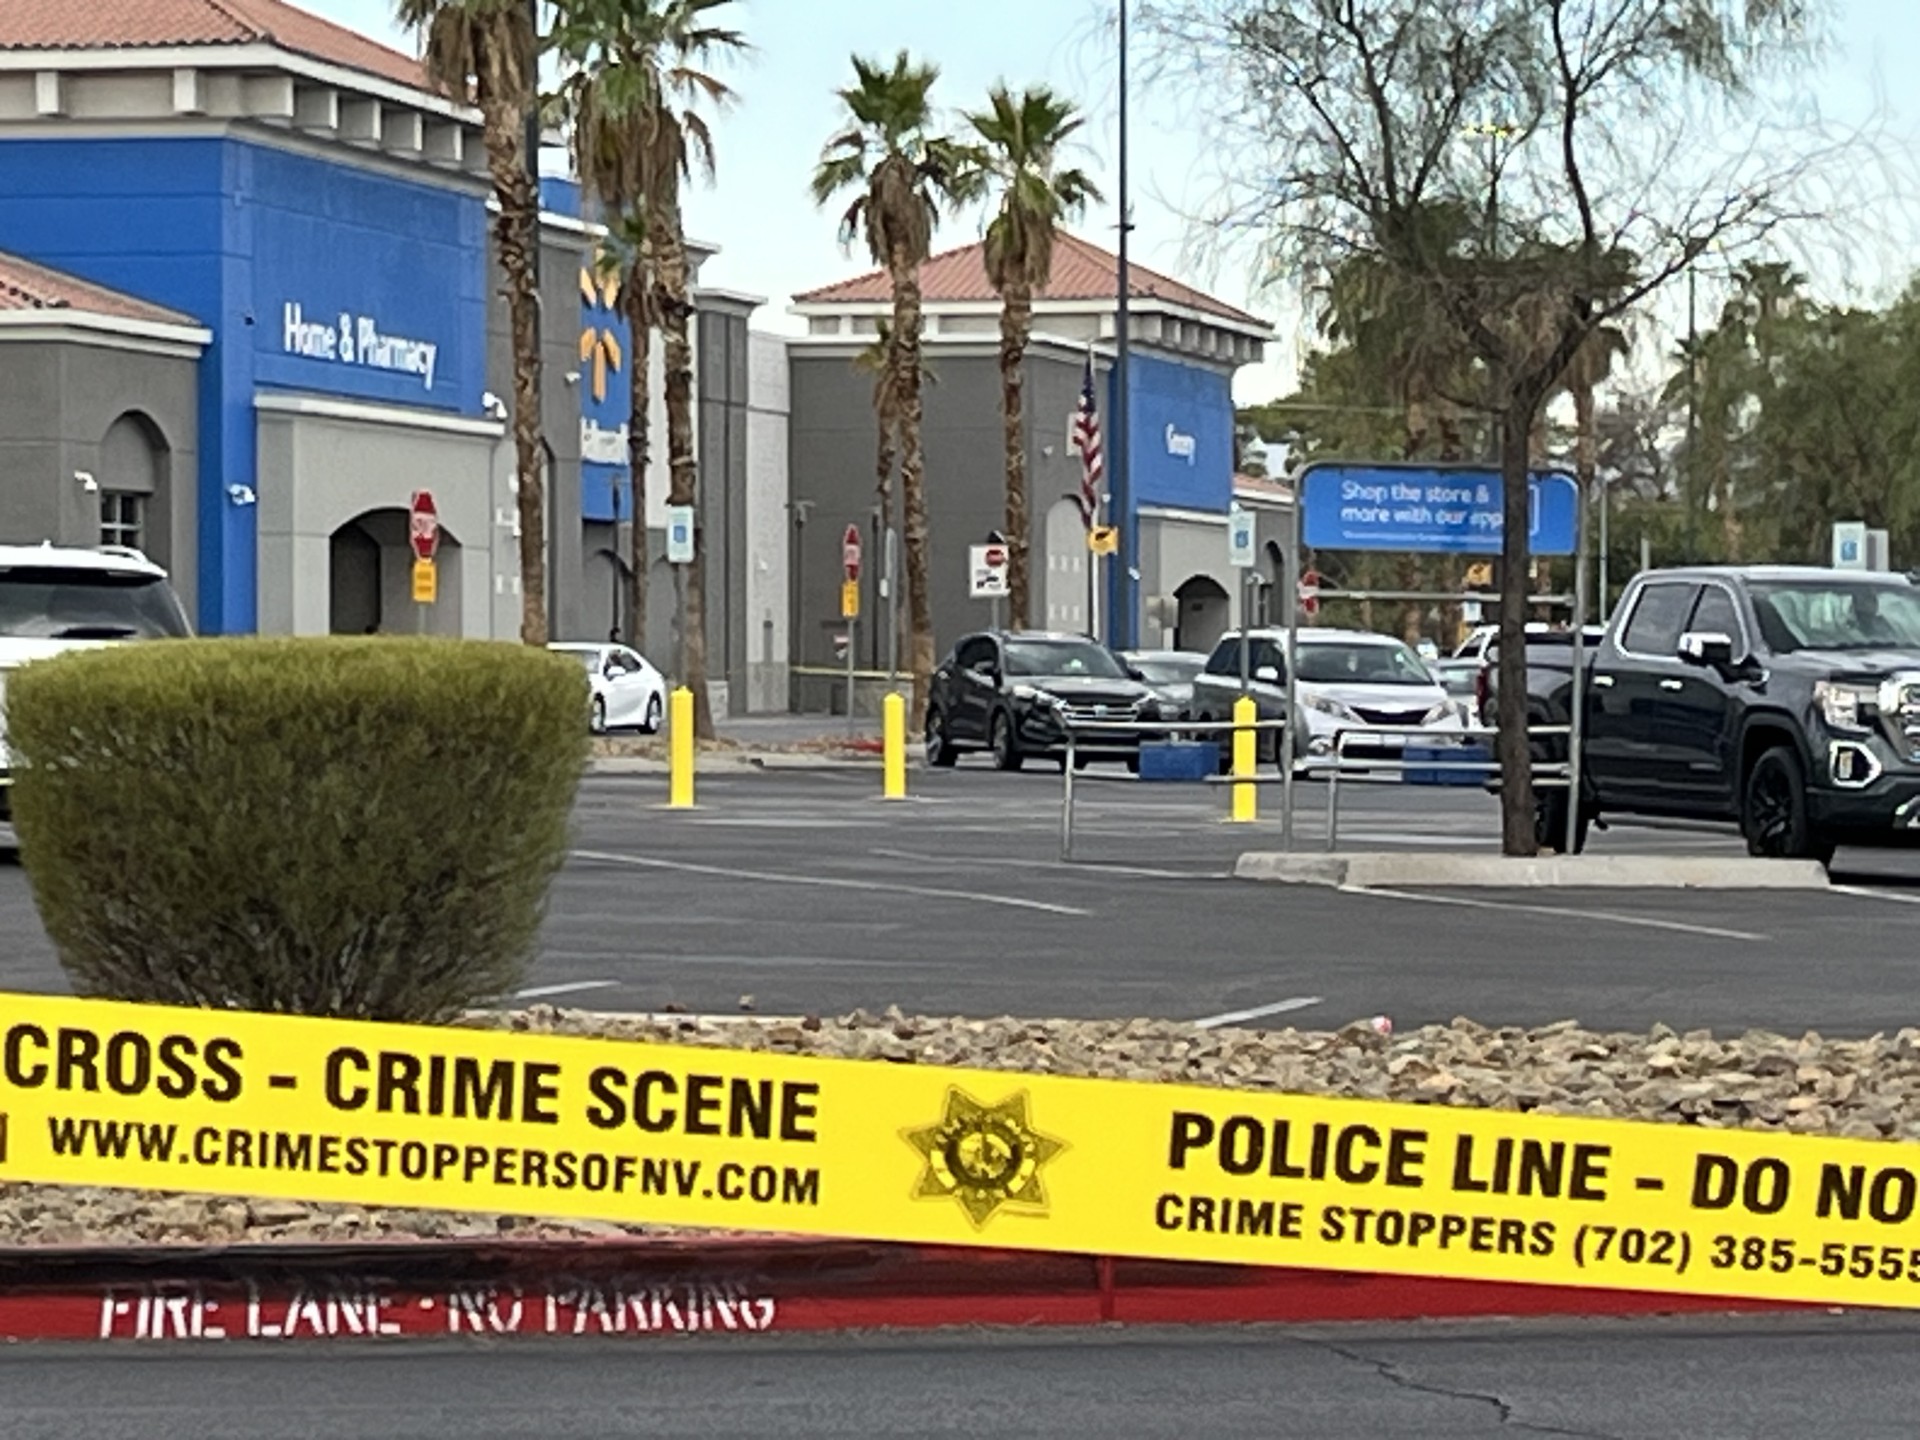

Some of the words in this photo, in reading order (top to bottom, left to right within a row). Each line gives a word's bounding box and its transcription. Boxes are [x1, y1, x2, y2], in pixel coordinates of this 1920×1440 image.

[284, 302, 336, 360] Home
[339, 312, 355, 363] &
[358, 316, 437, 391] Pharmacy
[1341, 480, 1388, 504] Shop
[1391, 482, 1421, 502] the
[1425, 486, 1472, 503] store
[1475, 484, 1489, 503] &
[1341, 507, 1390, 523] more
[1393, 505, 1432, 524] with
[1435, 509, 1467, 524] our
[4, 1023, 243, 1102] CROSS
[269, 1075, 297, 1089] -
[325, 1047, 562, 1125] CRIME
[586, 1066, 820, 1143] SCENE
[48, 1116, 820, 1205] WWW.CRIMESTOPPERSOFNV.COM
[1168, 1111, 1428, 1188] POLICE
[1451, 1134, 1612, 1202] LINE
[1635, 1177, 1664, 1191] -
[1691, 1153, 1790, 1215] DO
[1815, 1163, 1917, 1224] NO
[1155, 1193, 1304, 1239] CRIME
[1320, 1206, 1556, 1257] STOPPERS
[1574, 1225, 1691, 1274] (702)
[101, 1288, 226, 1339] FIRE
[248, 1287, 401, 1337] LANE
[449, 1288, 523, 1333] NO
[545, 1287, 776, 1334] PARKING
